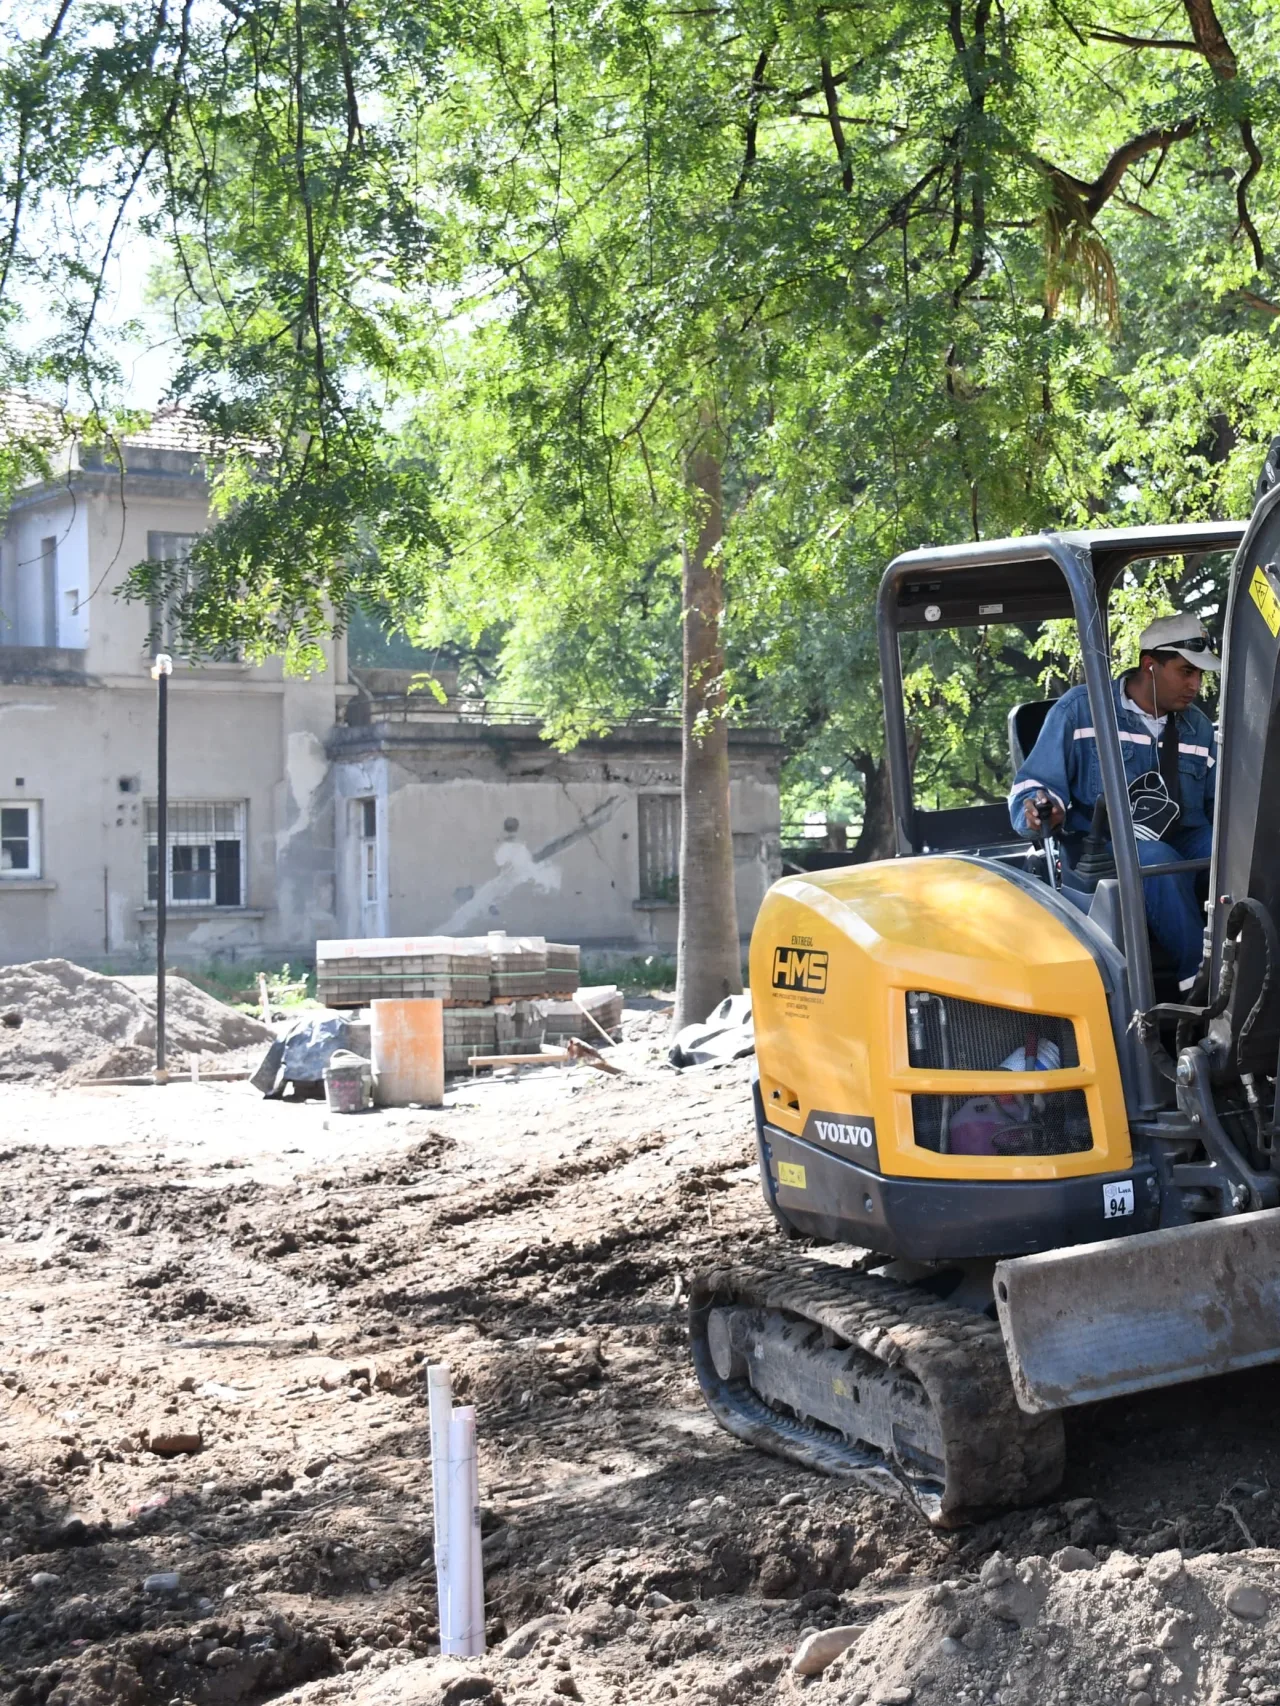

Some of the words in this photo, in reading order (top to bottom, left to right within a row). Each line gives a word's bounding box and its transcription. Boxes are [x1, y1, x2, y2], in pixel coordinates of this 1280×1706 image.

[773, 948, 828, 991] HMS
[814, 1120, 873, 1148] VOLVO
[1110, 1196, 1127, 1216] 94
